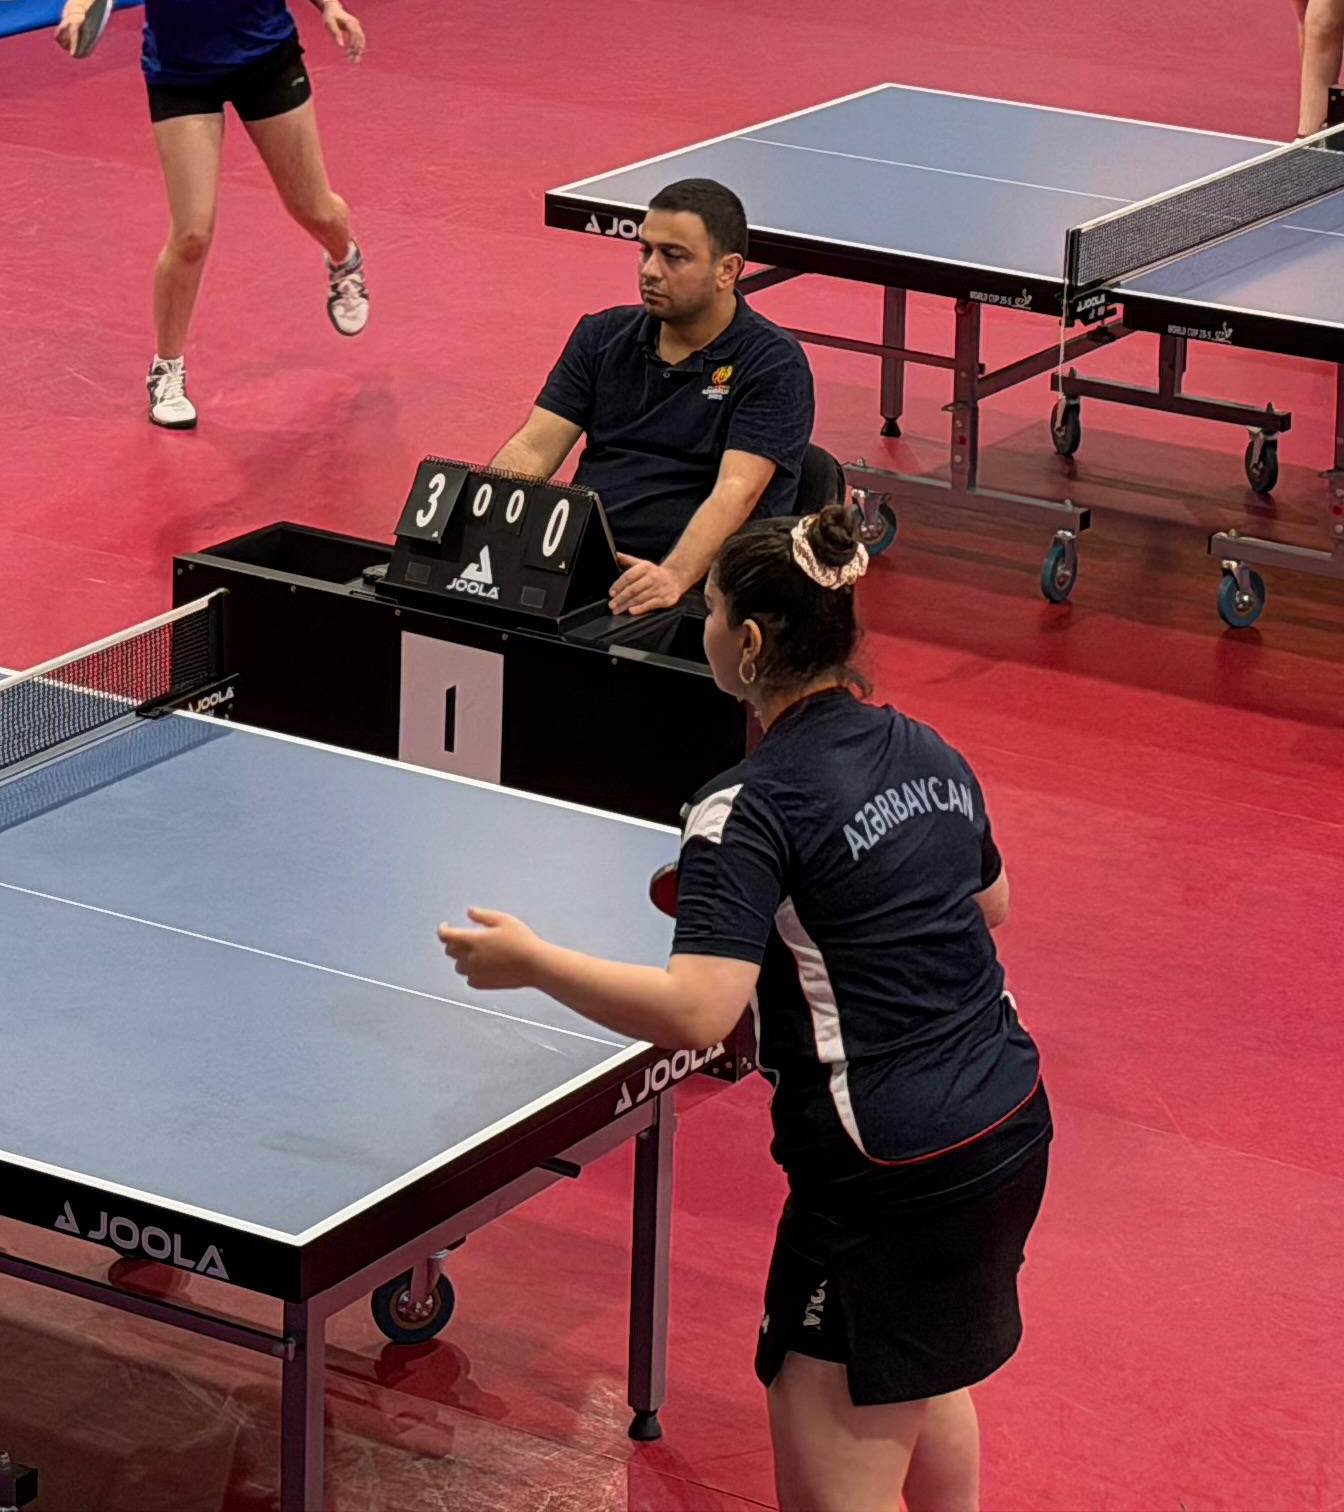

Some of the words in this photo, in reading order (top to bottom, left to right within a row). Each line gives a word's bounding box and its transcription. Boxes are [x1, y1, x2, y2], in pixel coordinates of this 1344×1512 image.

[415, 472, 447, 528] 3
[472, 483, 493, 518] 0
[506, 489, 525, 524] 0
[542, 498, 570, 558] 0
[446, 577, 500, 601] JOOLA
[195, 686, 235, 713] JOOLA
[444, 684, 457, 754] 1
[87, 1210, 230, 1281] JOOLA
